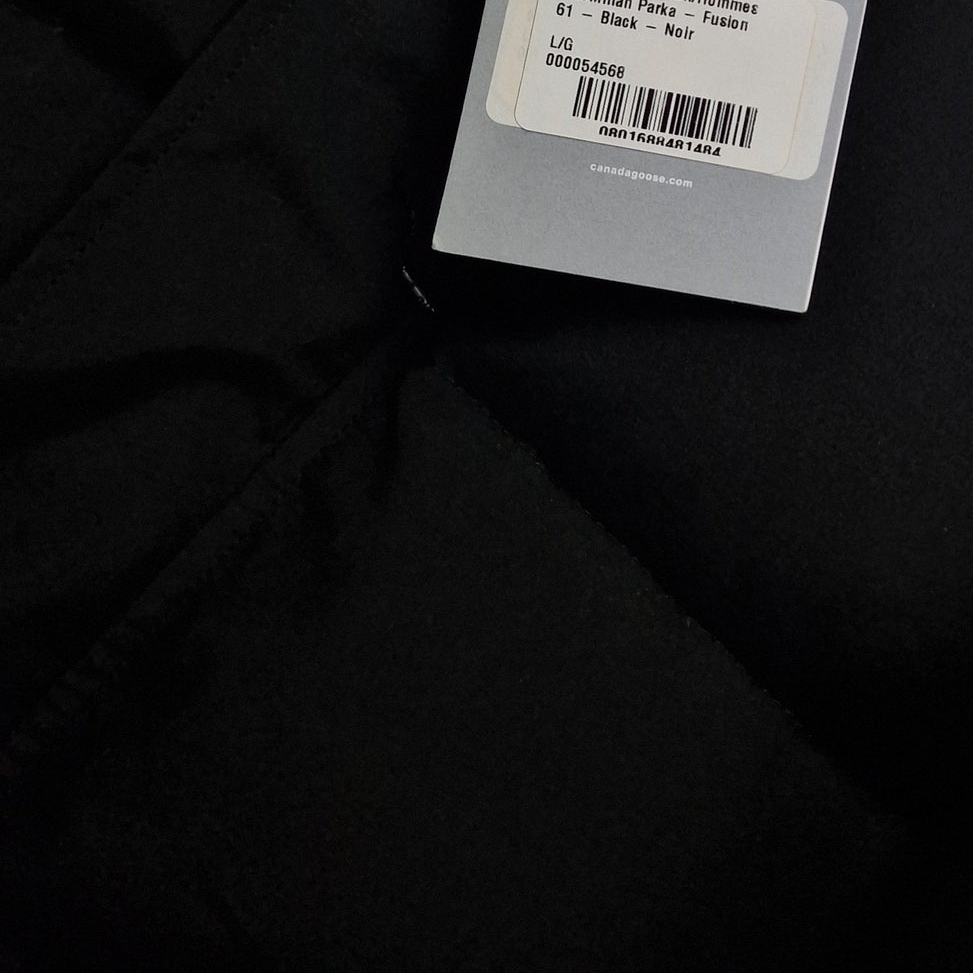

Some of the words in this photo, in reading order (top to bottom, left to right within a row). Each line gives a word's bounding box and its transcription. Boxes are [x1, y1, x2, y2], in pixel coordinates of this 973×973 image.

[556, 2, 573, 18] 61
[600, 10, 639, 30] Black
[664, 22, 695, 40] Noir
[702, 11, 749, 32] Fusion
[550, 35, 574, 51] L/G
[545, 53, 626, 79] 000054568
[590, 161, 694, 189] canadagoose.com
